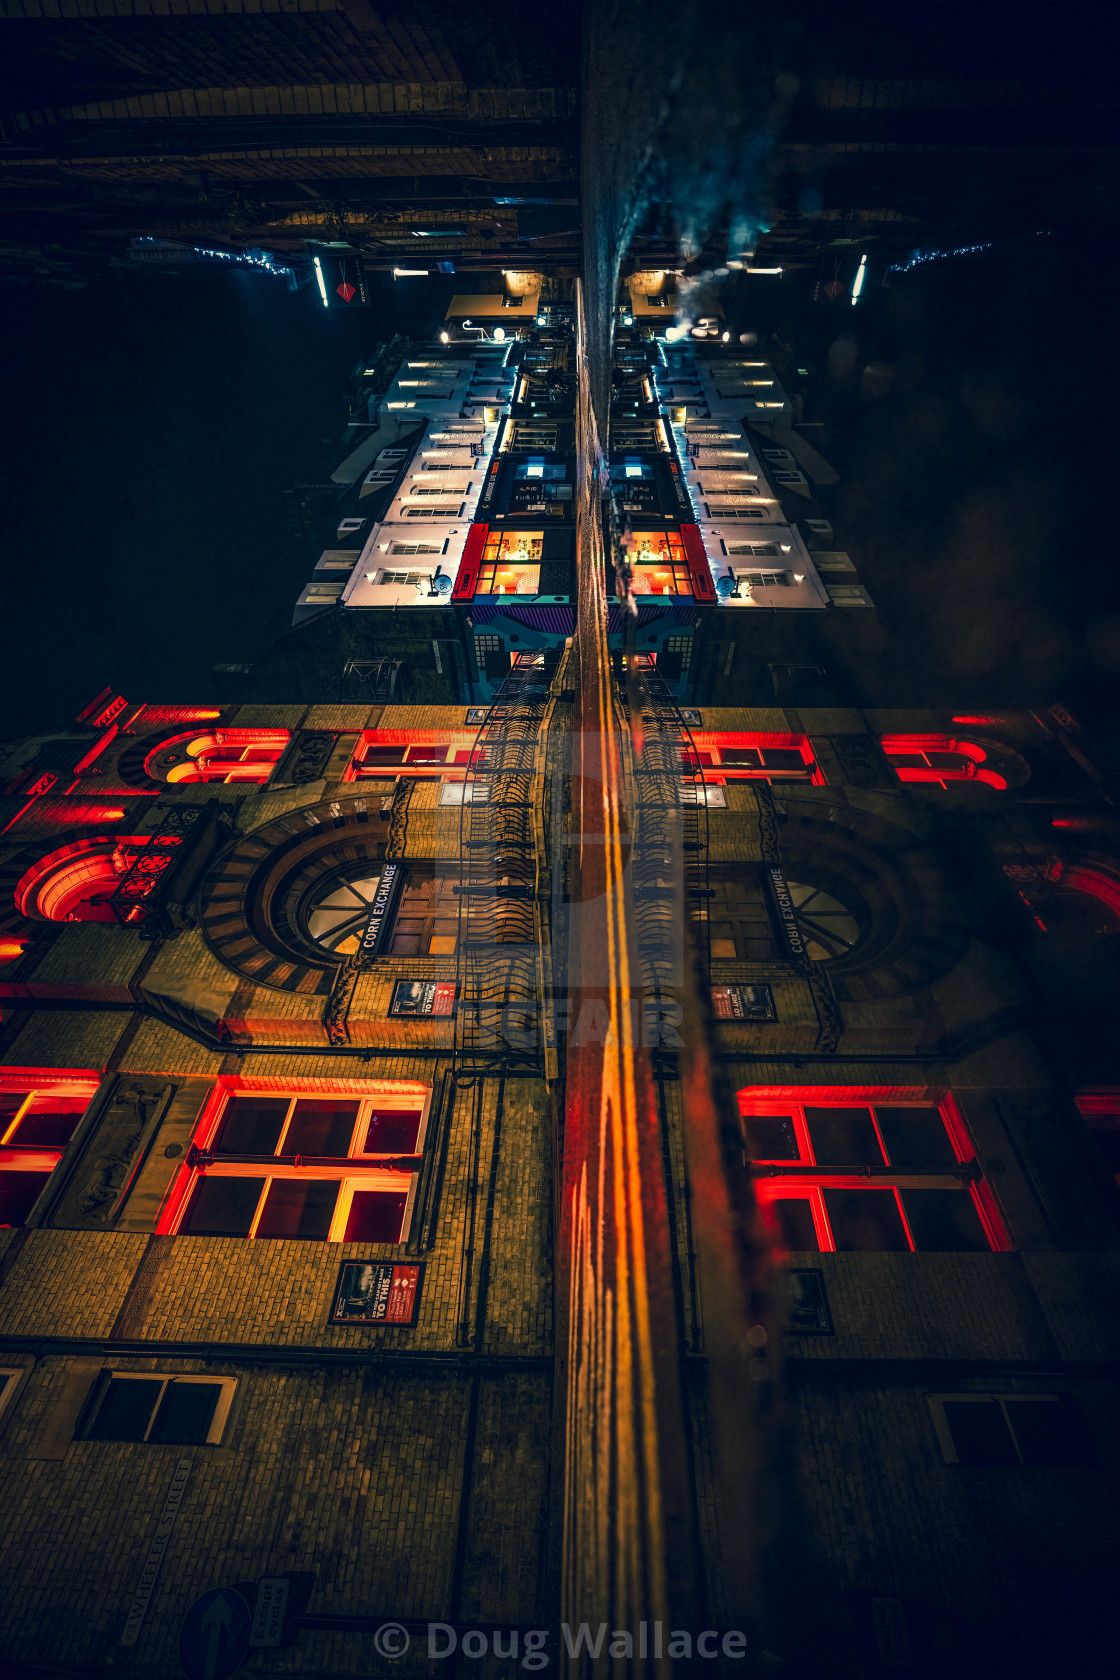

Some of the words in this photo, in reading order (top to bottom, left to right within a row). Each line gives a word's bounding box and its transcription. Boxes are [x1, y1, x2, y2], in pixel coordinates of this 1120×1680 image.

[372, 864, 398, 915] EXCHANGE
[363, 918, 382, 948] CORN
[425, 1004, 432, 1013] TO
[376, 1303, 386, 1318] TO
[128, 1534, 168, 1620] WHEELER
[160, 1463, 190, 1526] STREET
[254, 1583, 273, 1640] Except
[268, 1586, 285, 1638] cycles
